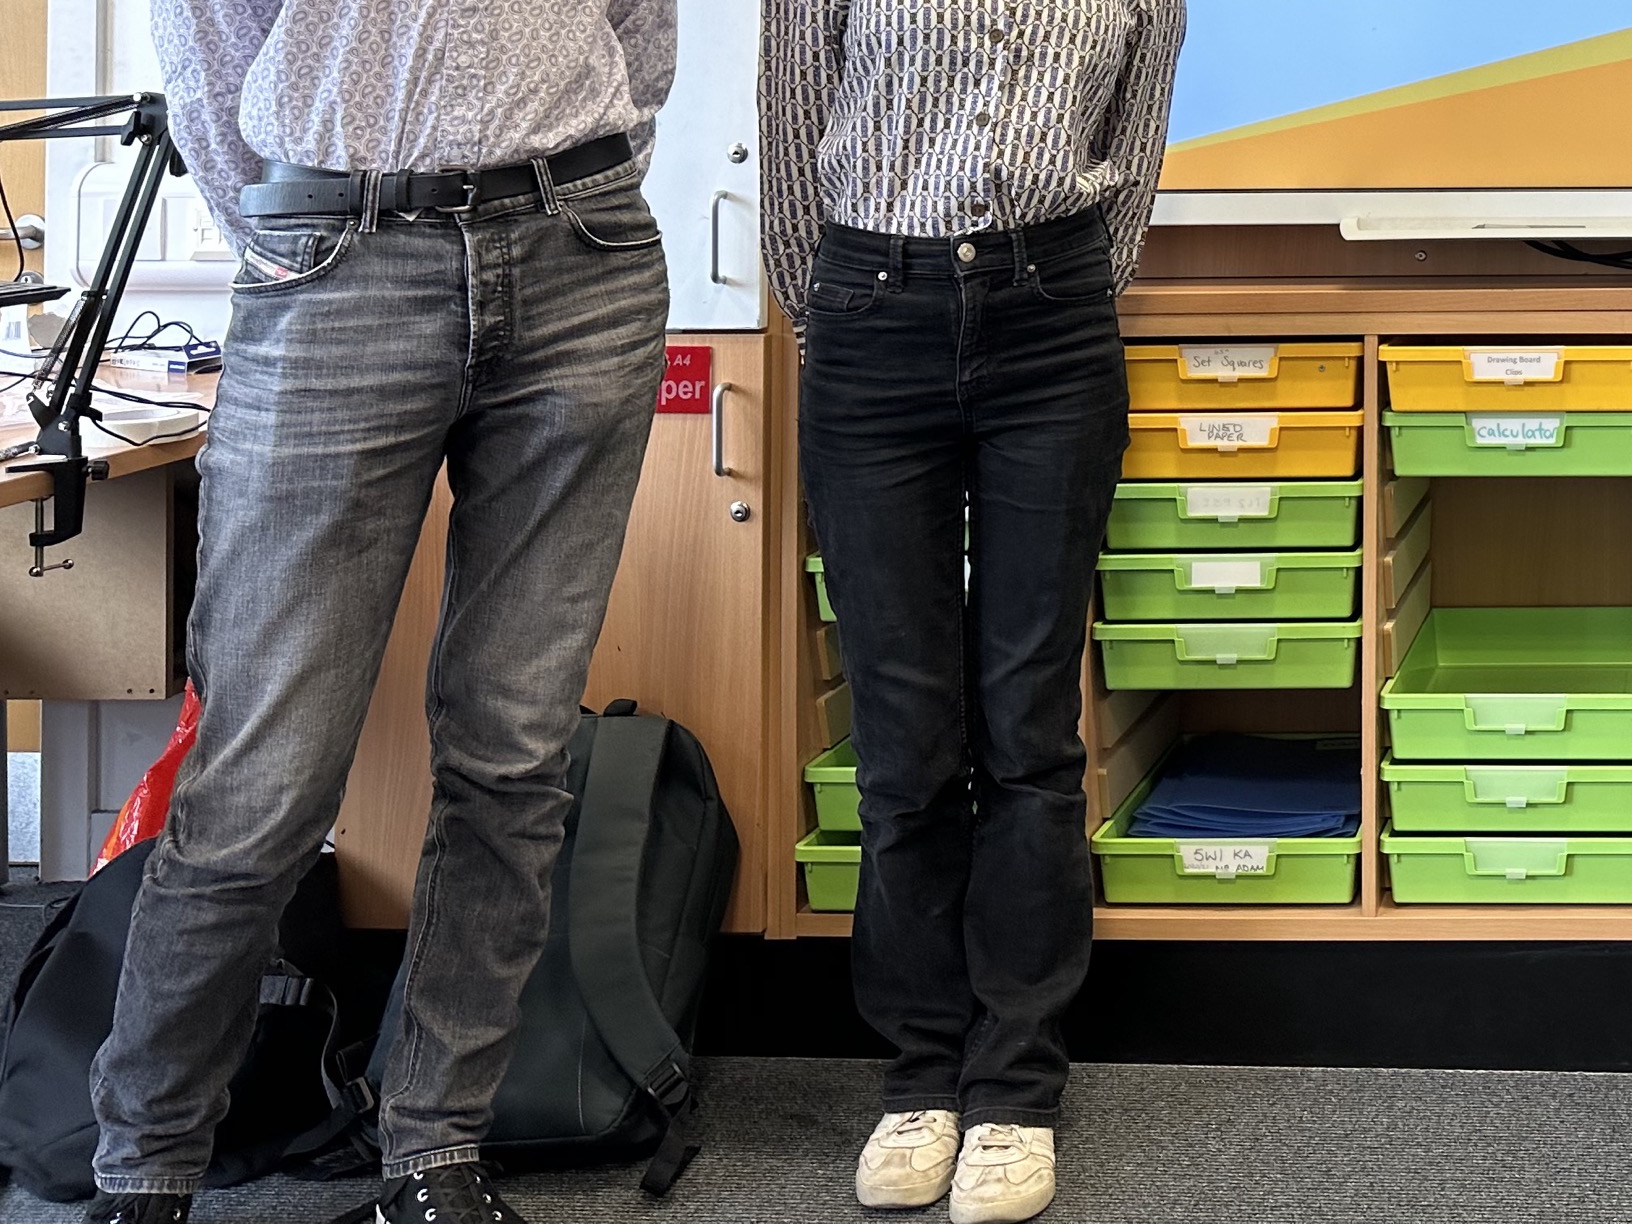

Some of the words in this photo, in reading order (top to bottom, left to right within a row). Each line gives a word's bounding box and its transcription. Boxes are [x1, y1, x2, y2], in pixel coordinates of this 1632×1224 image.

[672, 353, 692, 366] A4
[1193, 356, 1211, 368] Set
[1220, 355, 1264, 372] Squares
[1486, 356, 1517, 365] Drawing
[1518, 355, 1541, 364] Board
[1505, 368, 1523, 377] Clips
[660, 379, 706, 406] per
[1199, 422, 1243, 433] LINED
[1207, 432, 1248, 442] PAPER
